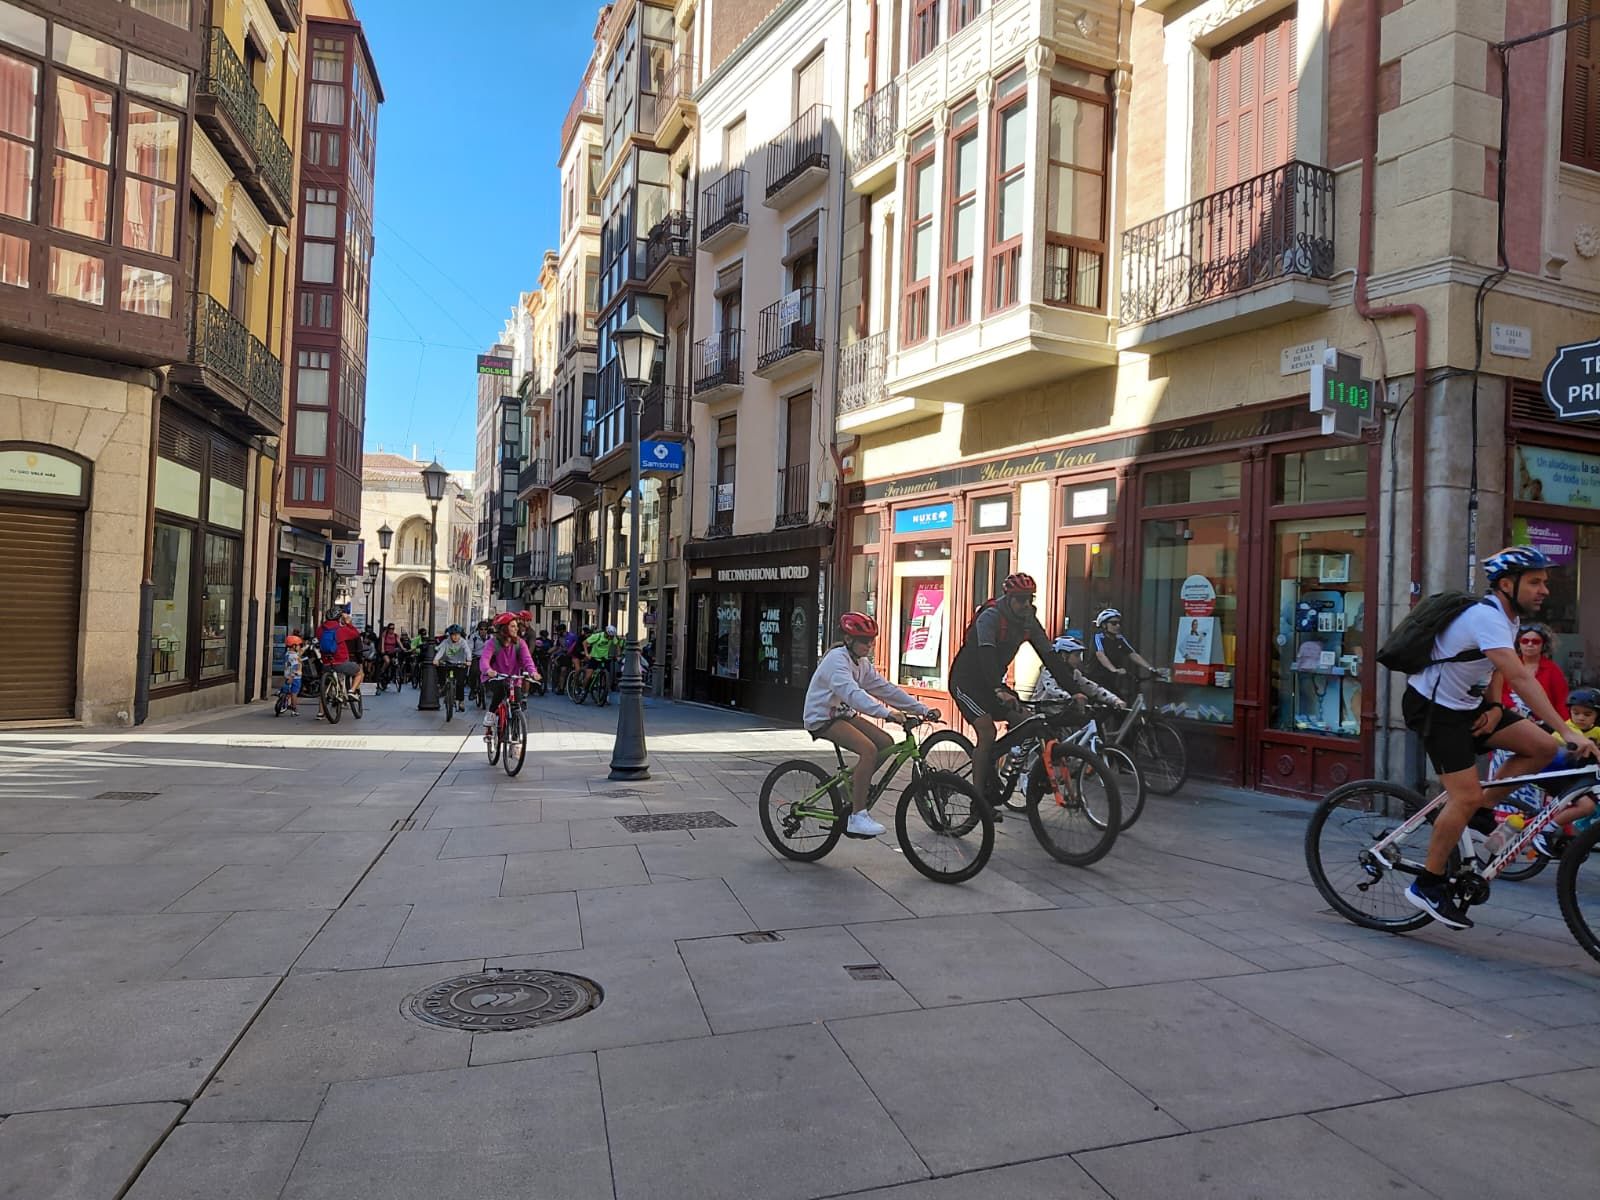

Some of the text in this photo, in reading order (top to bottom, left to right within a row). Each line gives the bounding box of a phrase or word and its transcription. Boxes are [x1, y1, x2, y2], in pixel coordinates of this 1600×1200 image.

[1295, 344, 1315, 355] CALLE
[1328, 379, 1368, 410] 11:03
[1162, 422, 1271, 450] Farmacia
[642, 459, 680, 469] Samsonite
[884, 448, 1097, 498] Farmacia Yolanda Vara
[912, 513, 938, 524] NUXE
[718, 565, 809, 581] UNCONVENTIONAL WORLD
[716, 607, 742, 621] SHOCK
[760, 621, 780, 634] GUSTA
[764, 646, 779, 659] DAR
[768, 659, 779, 672] ME
